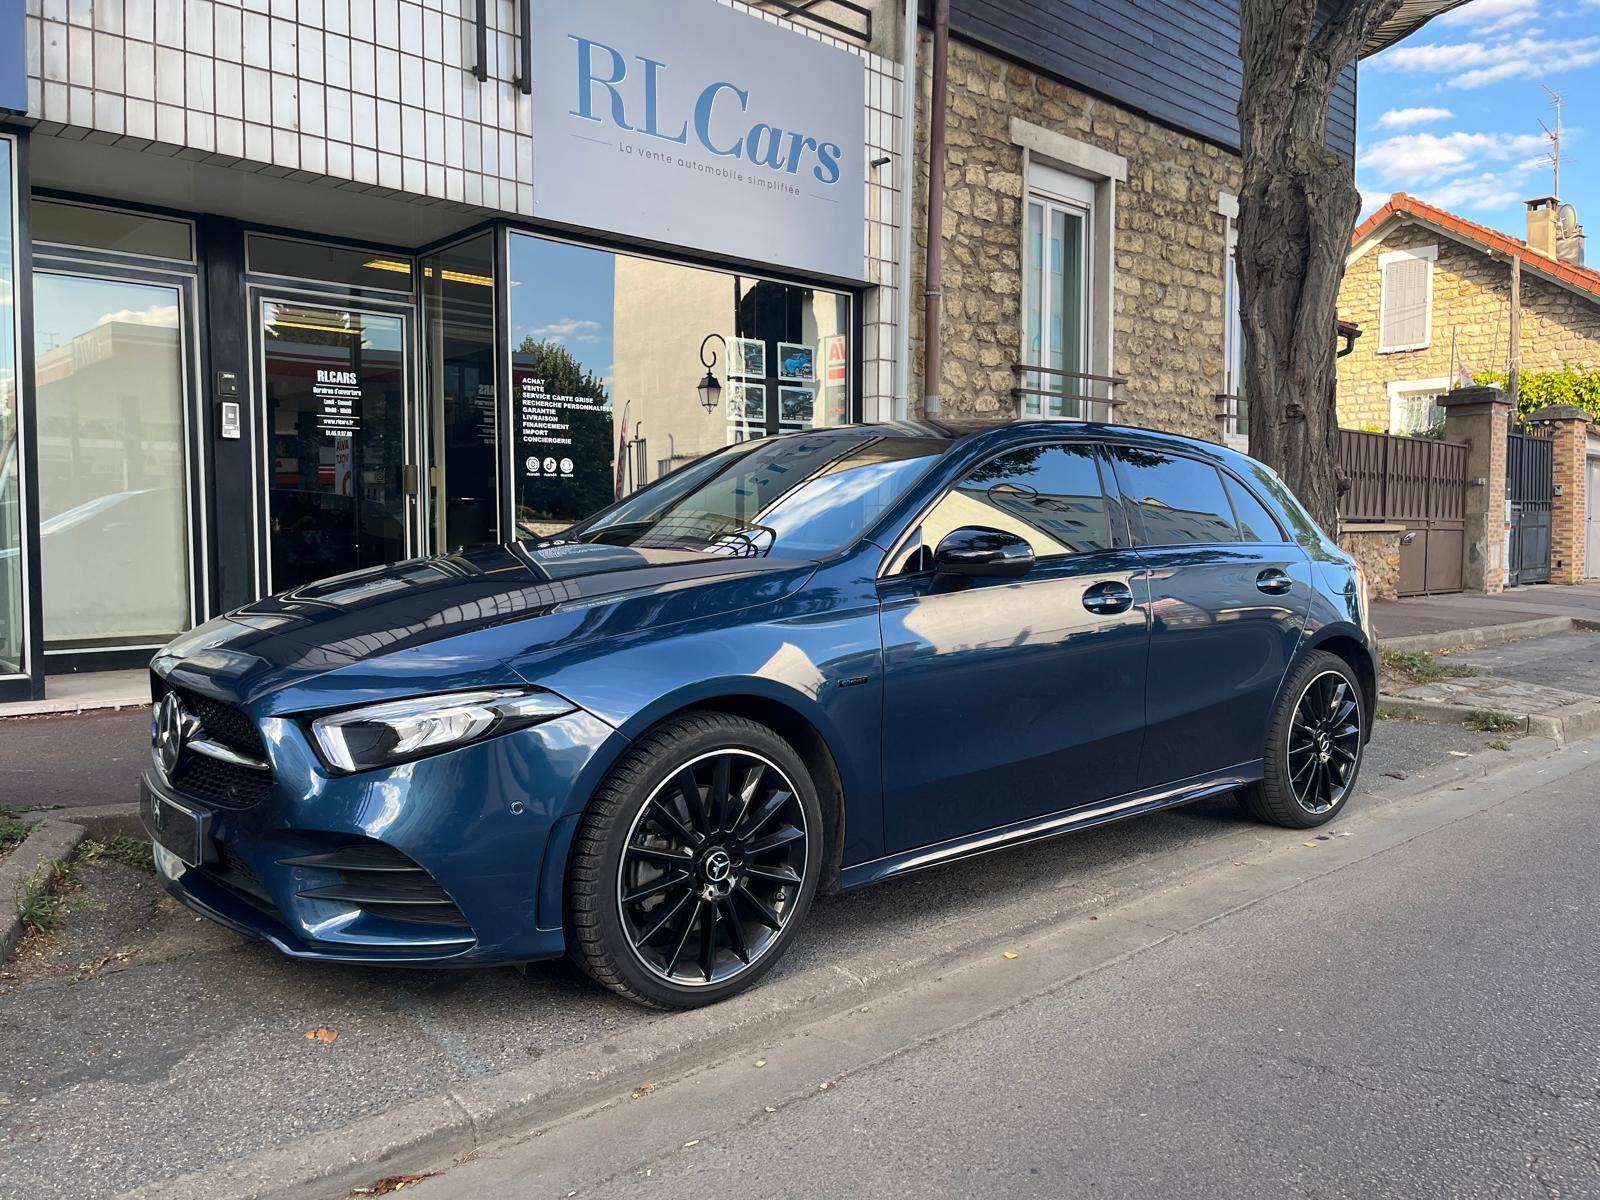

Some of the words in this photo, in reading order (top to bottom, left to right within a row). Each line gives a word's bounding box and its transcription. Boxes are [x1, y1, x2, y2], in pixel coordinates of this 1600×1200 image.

[567, 33, 843, 186] RLCars
[619, 141, 633, 154] La
[638, 148, 673, 164] vente
[677, 156, 743, 182] automobile
[747, 175, 801, 197] simplifiée
[317, 370, 357, 384] RLCARS
[523, 400, 562, 408] RECHERCHE
[523, 422, 569, 430] FINANCEMENT
